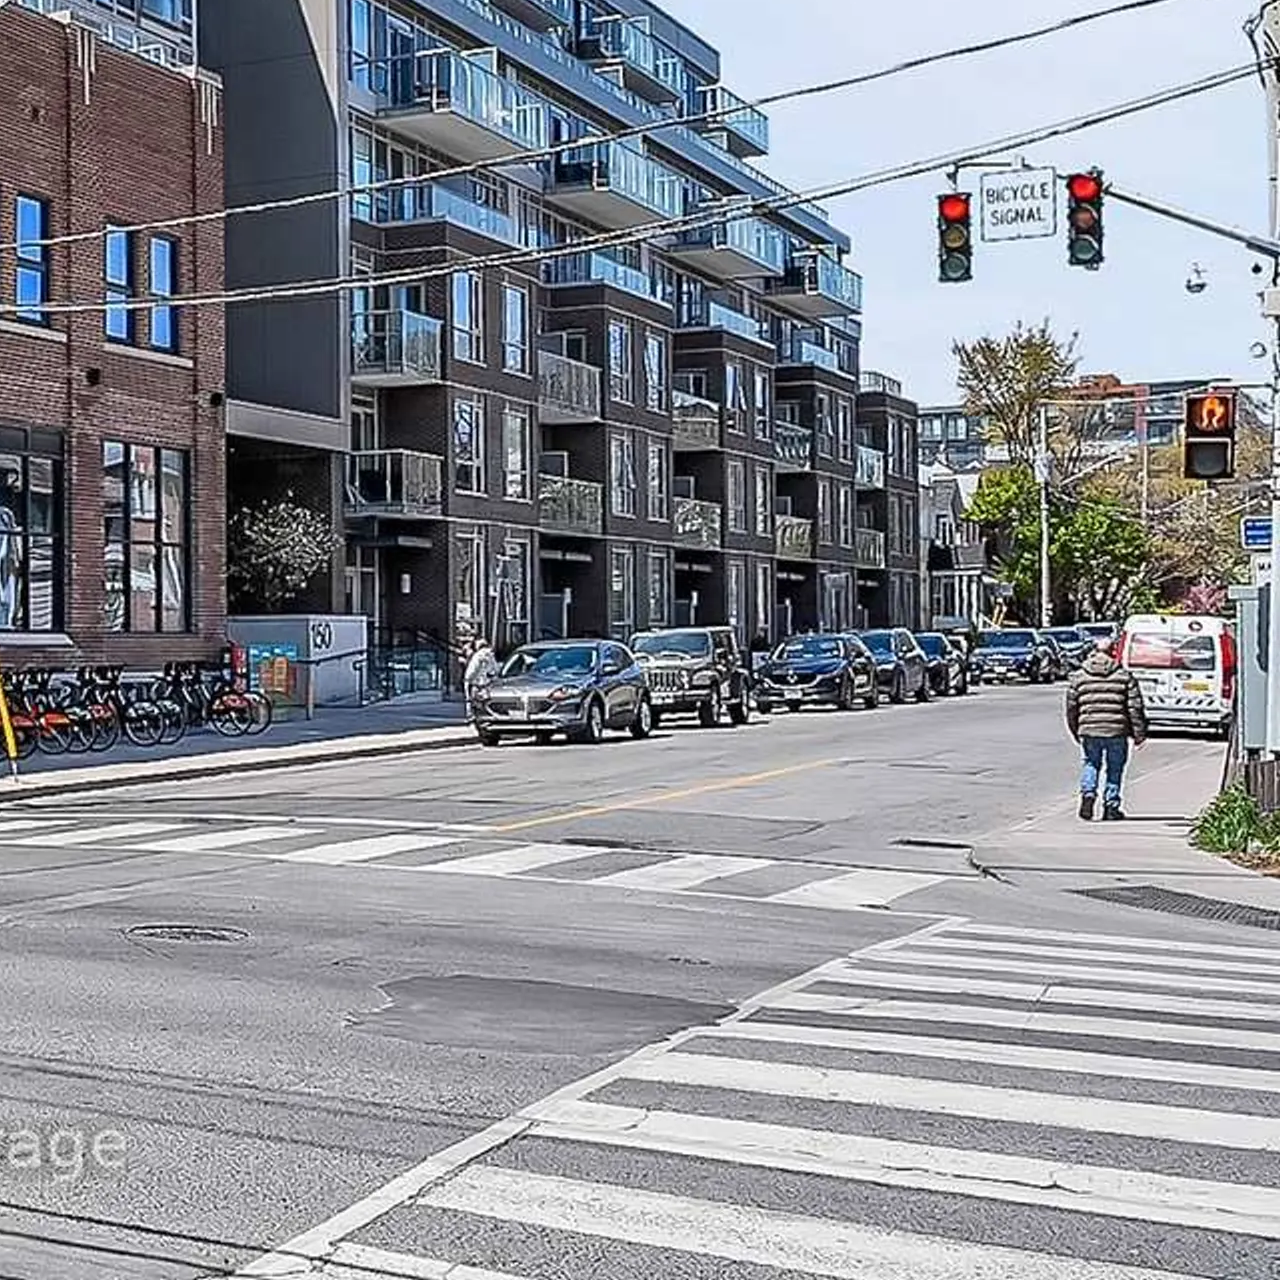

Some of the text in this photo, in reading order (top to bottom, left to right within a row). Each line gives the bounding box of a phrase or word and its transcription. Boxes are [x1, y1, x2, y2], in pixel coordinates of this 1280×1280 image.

[986, 182, 1049, 205] BICYCLE
[990, 207, 1047, 227] SIGNAL
[311, 623, 331, 649] 150
